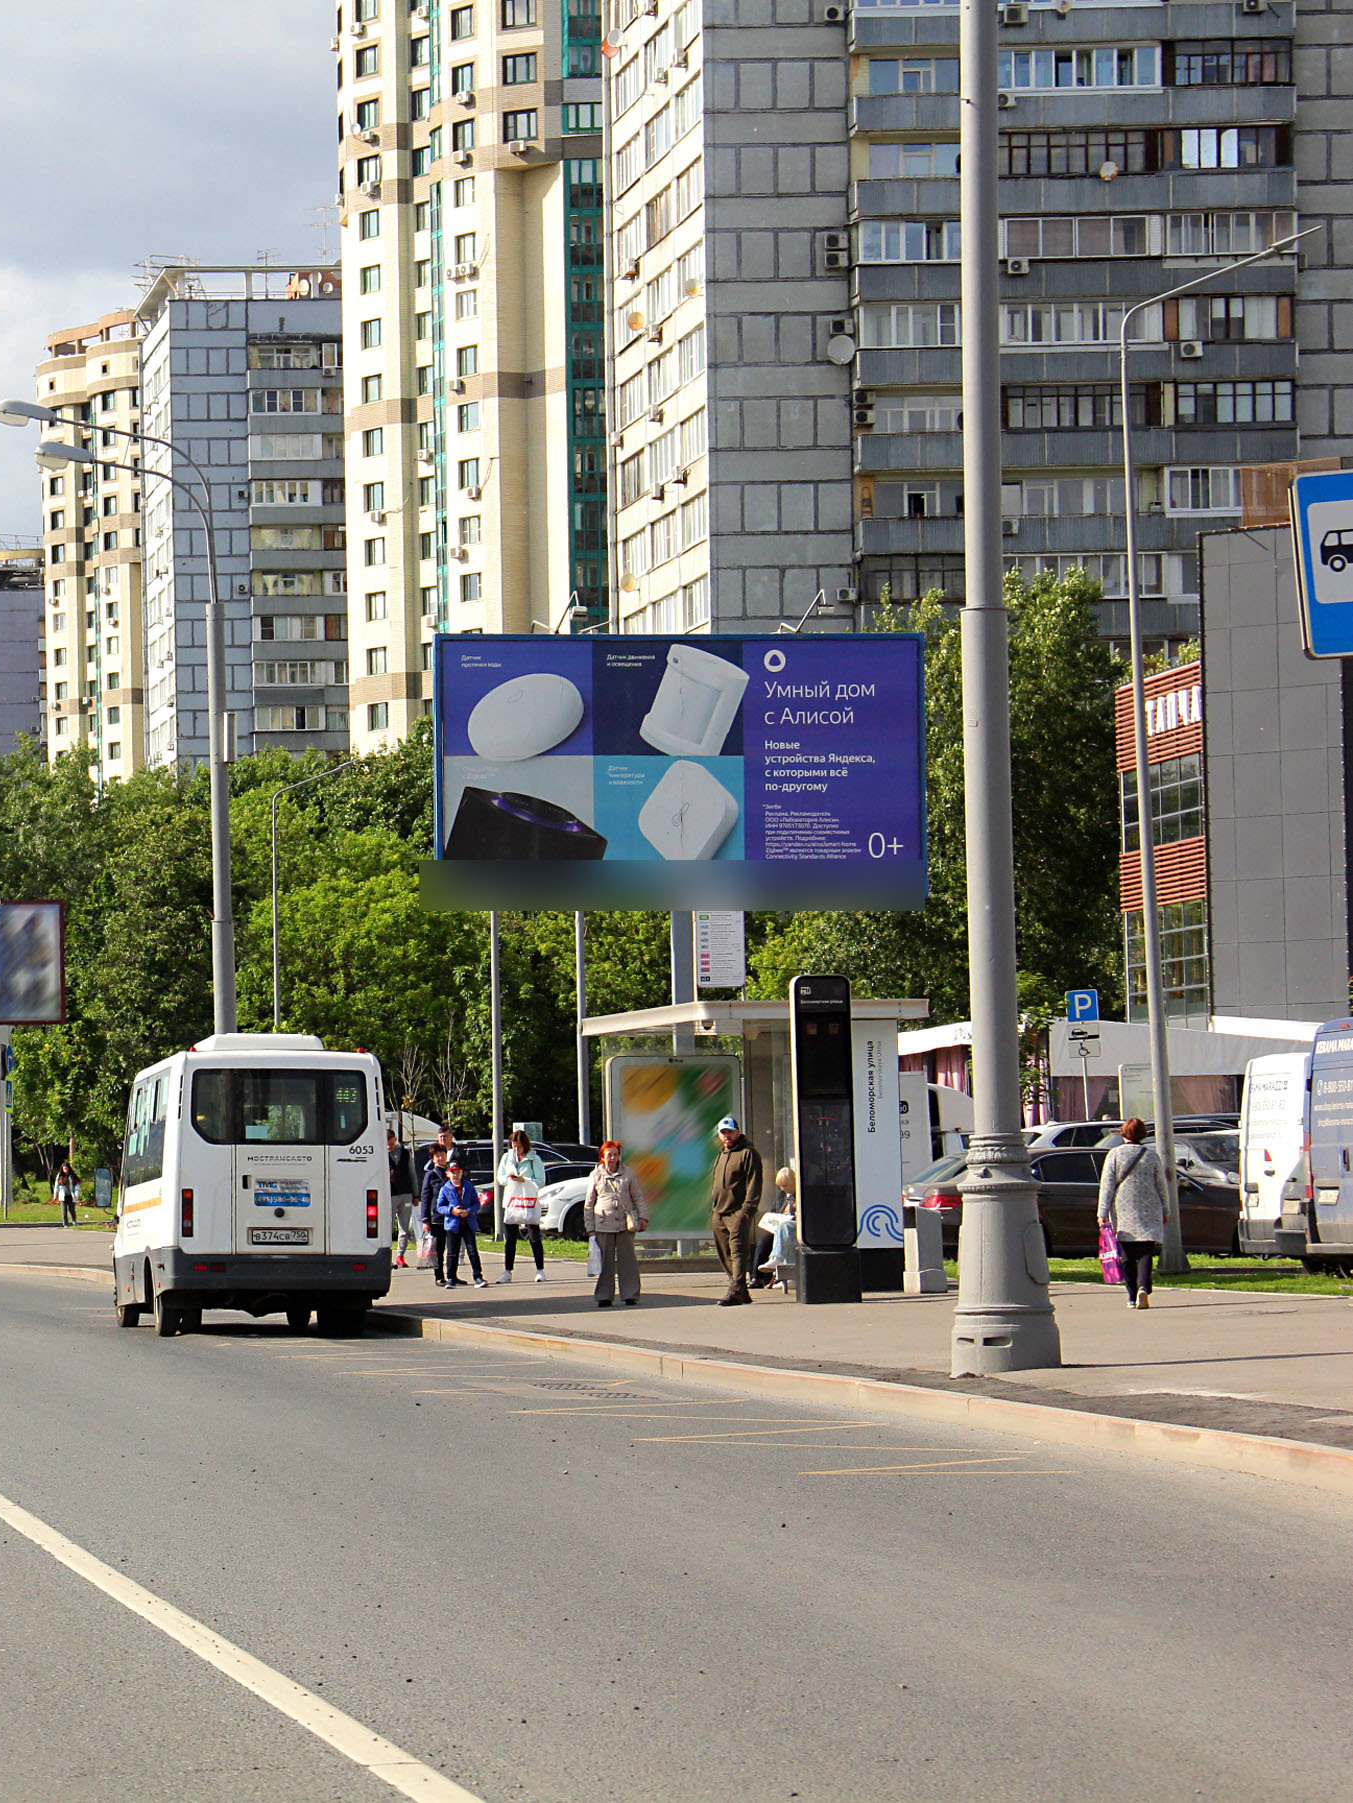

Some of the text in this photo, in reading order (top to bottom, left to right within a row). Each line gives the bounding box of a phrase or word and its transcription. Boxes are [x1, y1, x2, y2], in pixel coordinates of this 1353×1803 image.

[764, 681, 875, 701] Умный дом
[764, 706, 854, 725] с Алисой
[765, 740, 800, 750] Новые
[765, 753, 876, 765] устройства Яндекса,
[773, 769, 827, 779] которыми
[830, 767, 848, 777] всё
[765, 782, 828, 793] по-другому
[868, 832, 904, 859] 0+
[1074, 994, 1092, 1019] P
[867, 1040, 876, 1133] Беломорская улица
[349, 1145, 374, 1155] 6053
